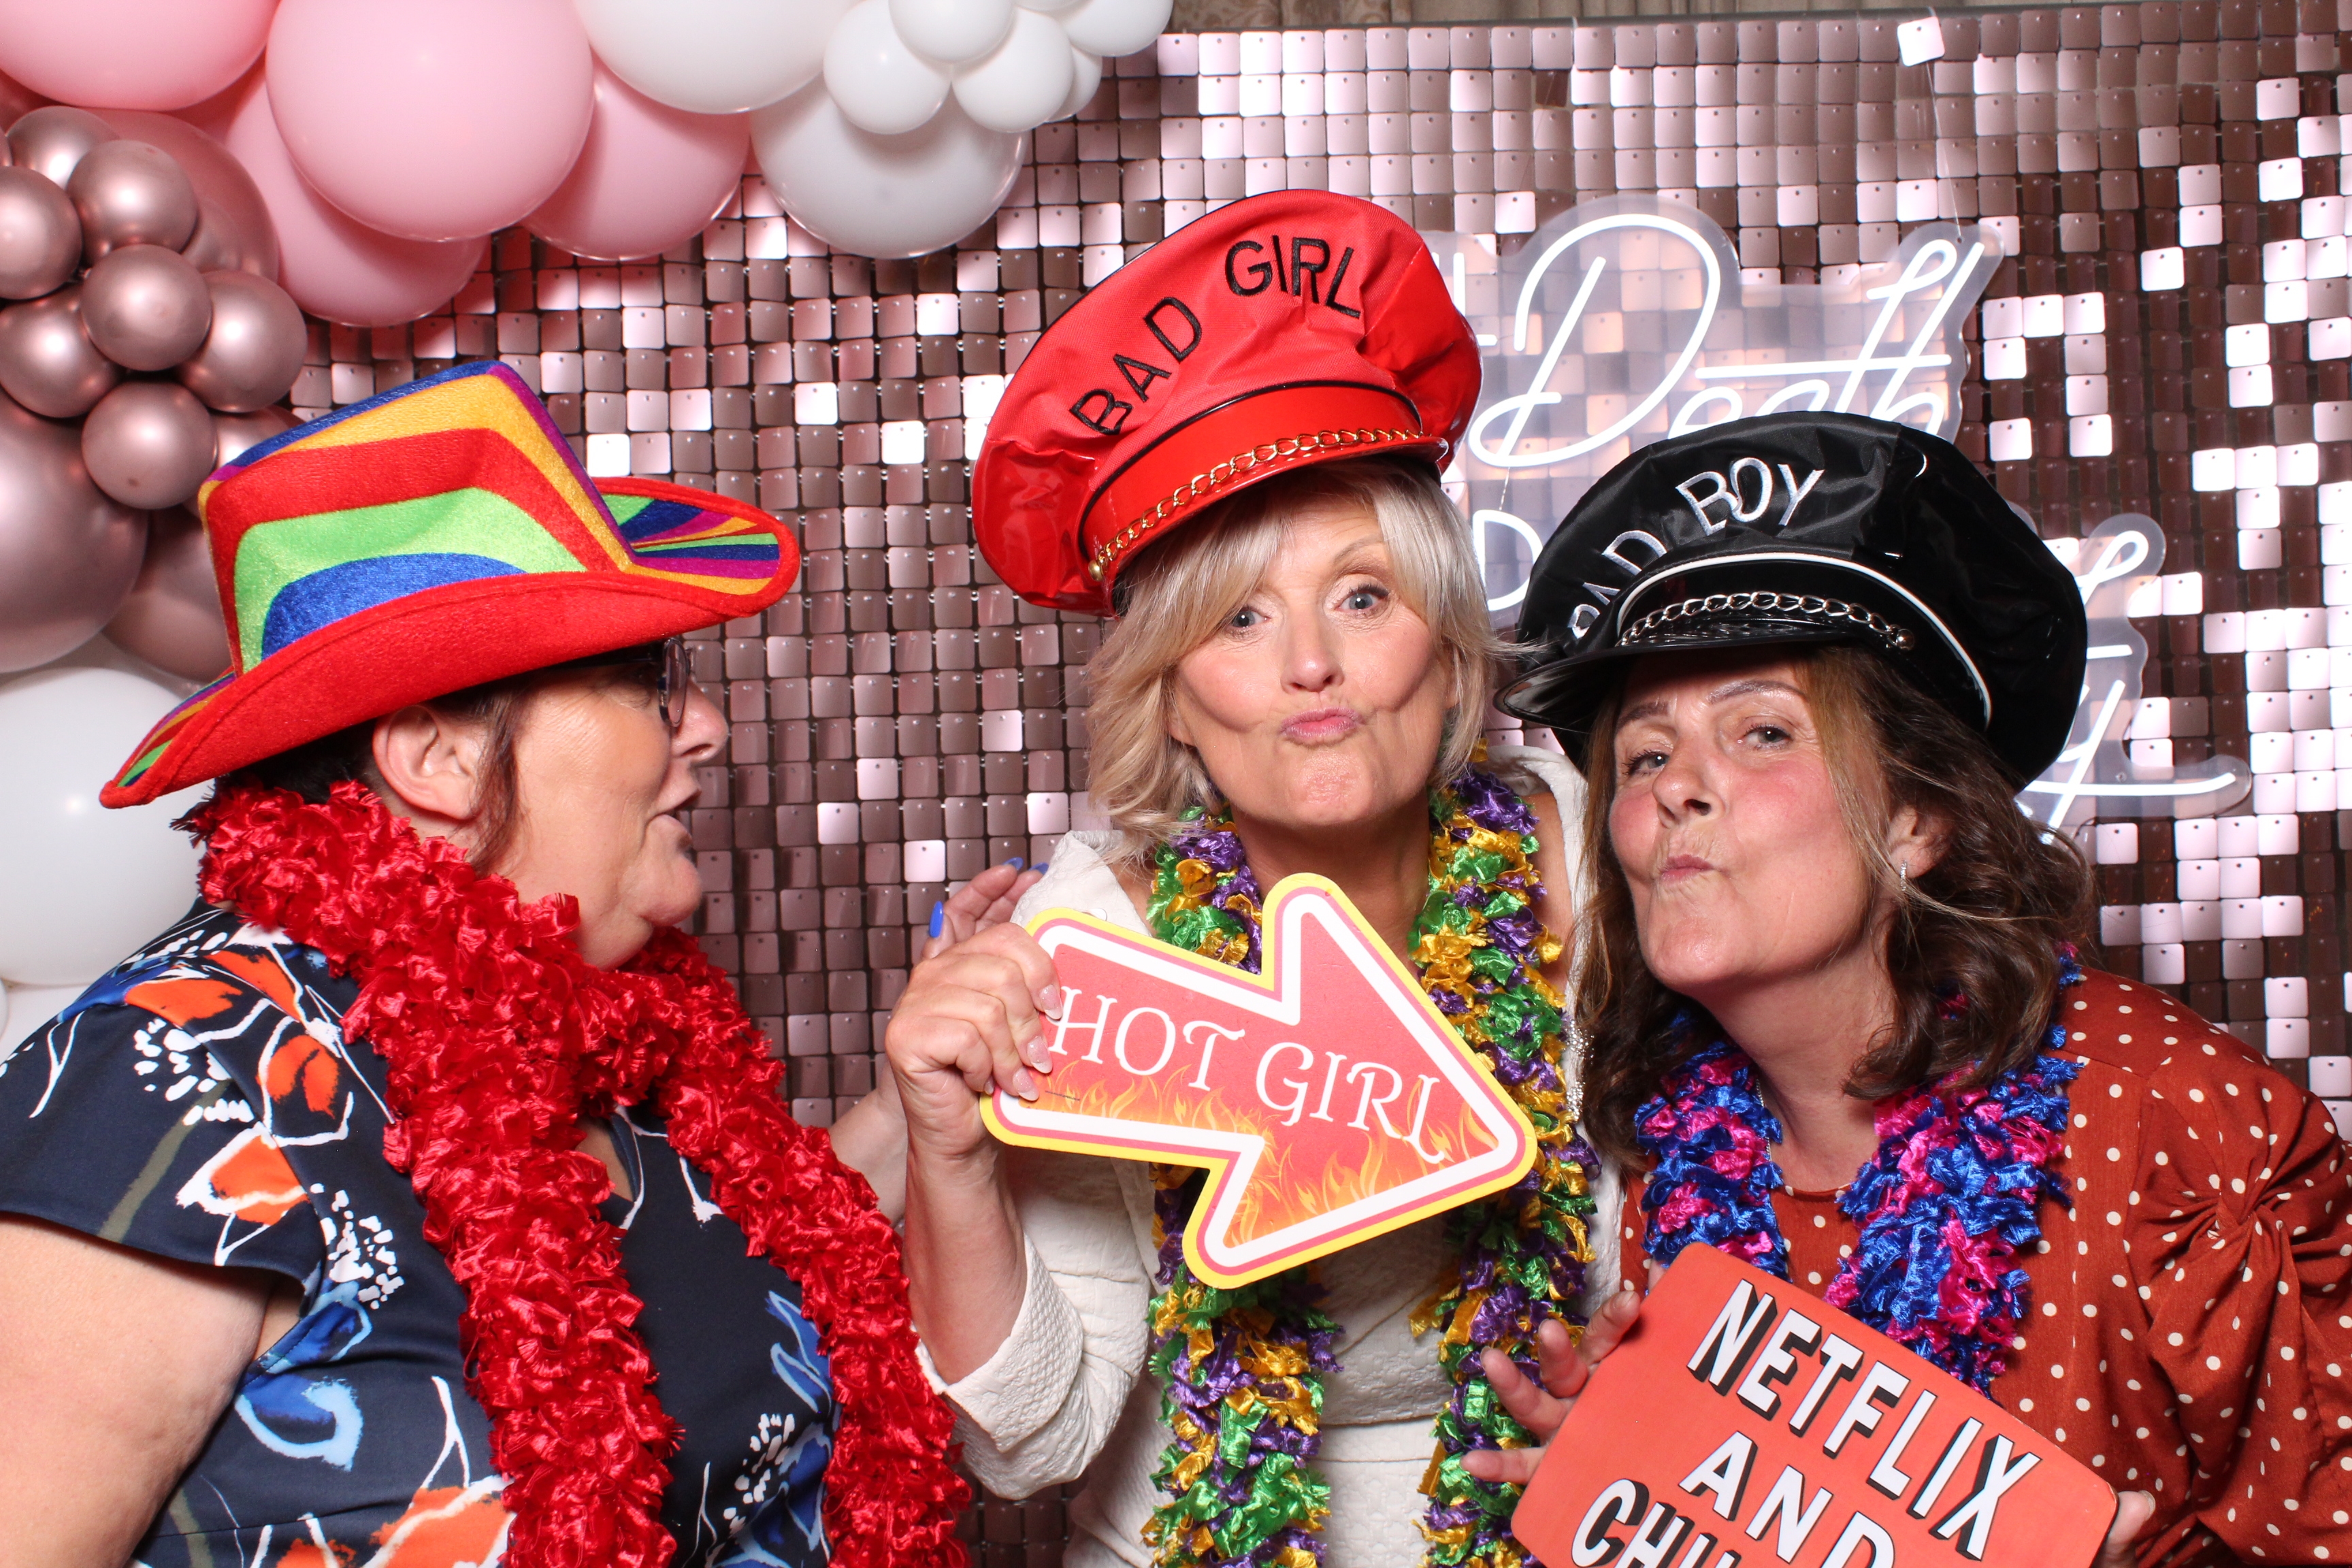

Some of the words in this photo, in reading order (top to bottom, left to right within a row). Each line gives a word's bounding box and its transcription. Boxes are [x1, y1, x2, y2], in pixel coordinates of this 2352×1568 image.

[1069, 297, 1203, 436] BAD
[1225, 235, 1362, 319] GIRL
[1675, 457, 1826, 536] BOY
[1045, 985, 1246, 1092] HOT
[1256, 1041, 1446, 1165] GIRL
[1678, 1431, 1896, 1568] AND
[1686, 1278, 2042, 1562] NETFLIX
